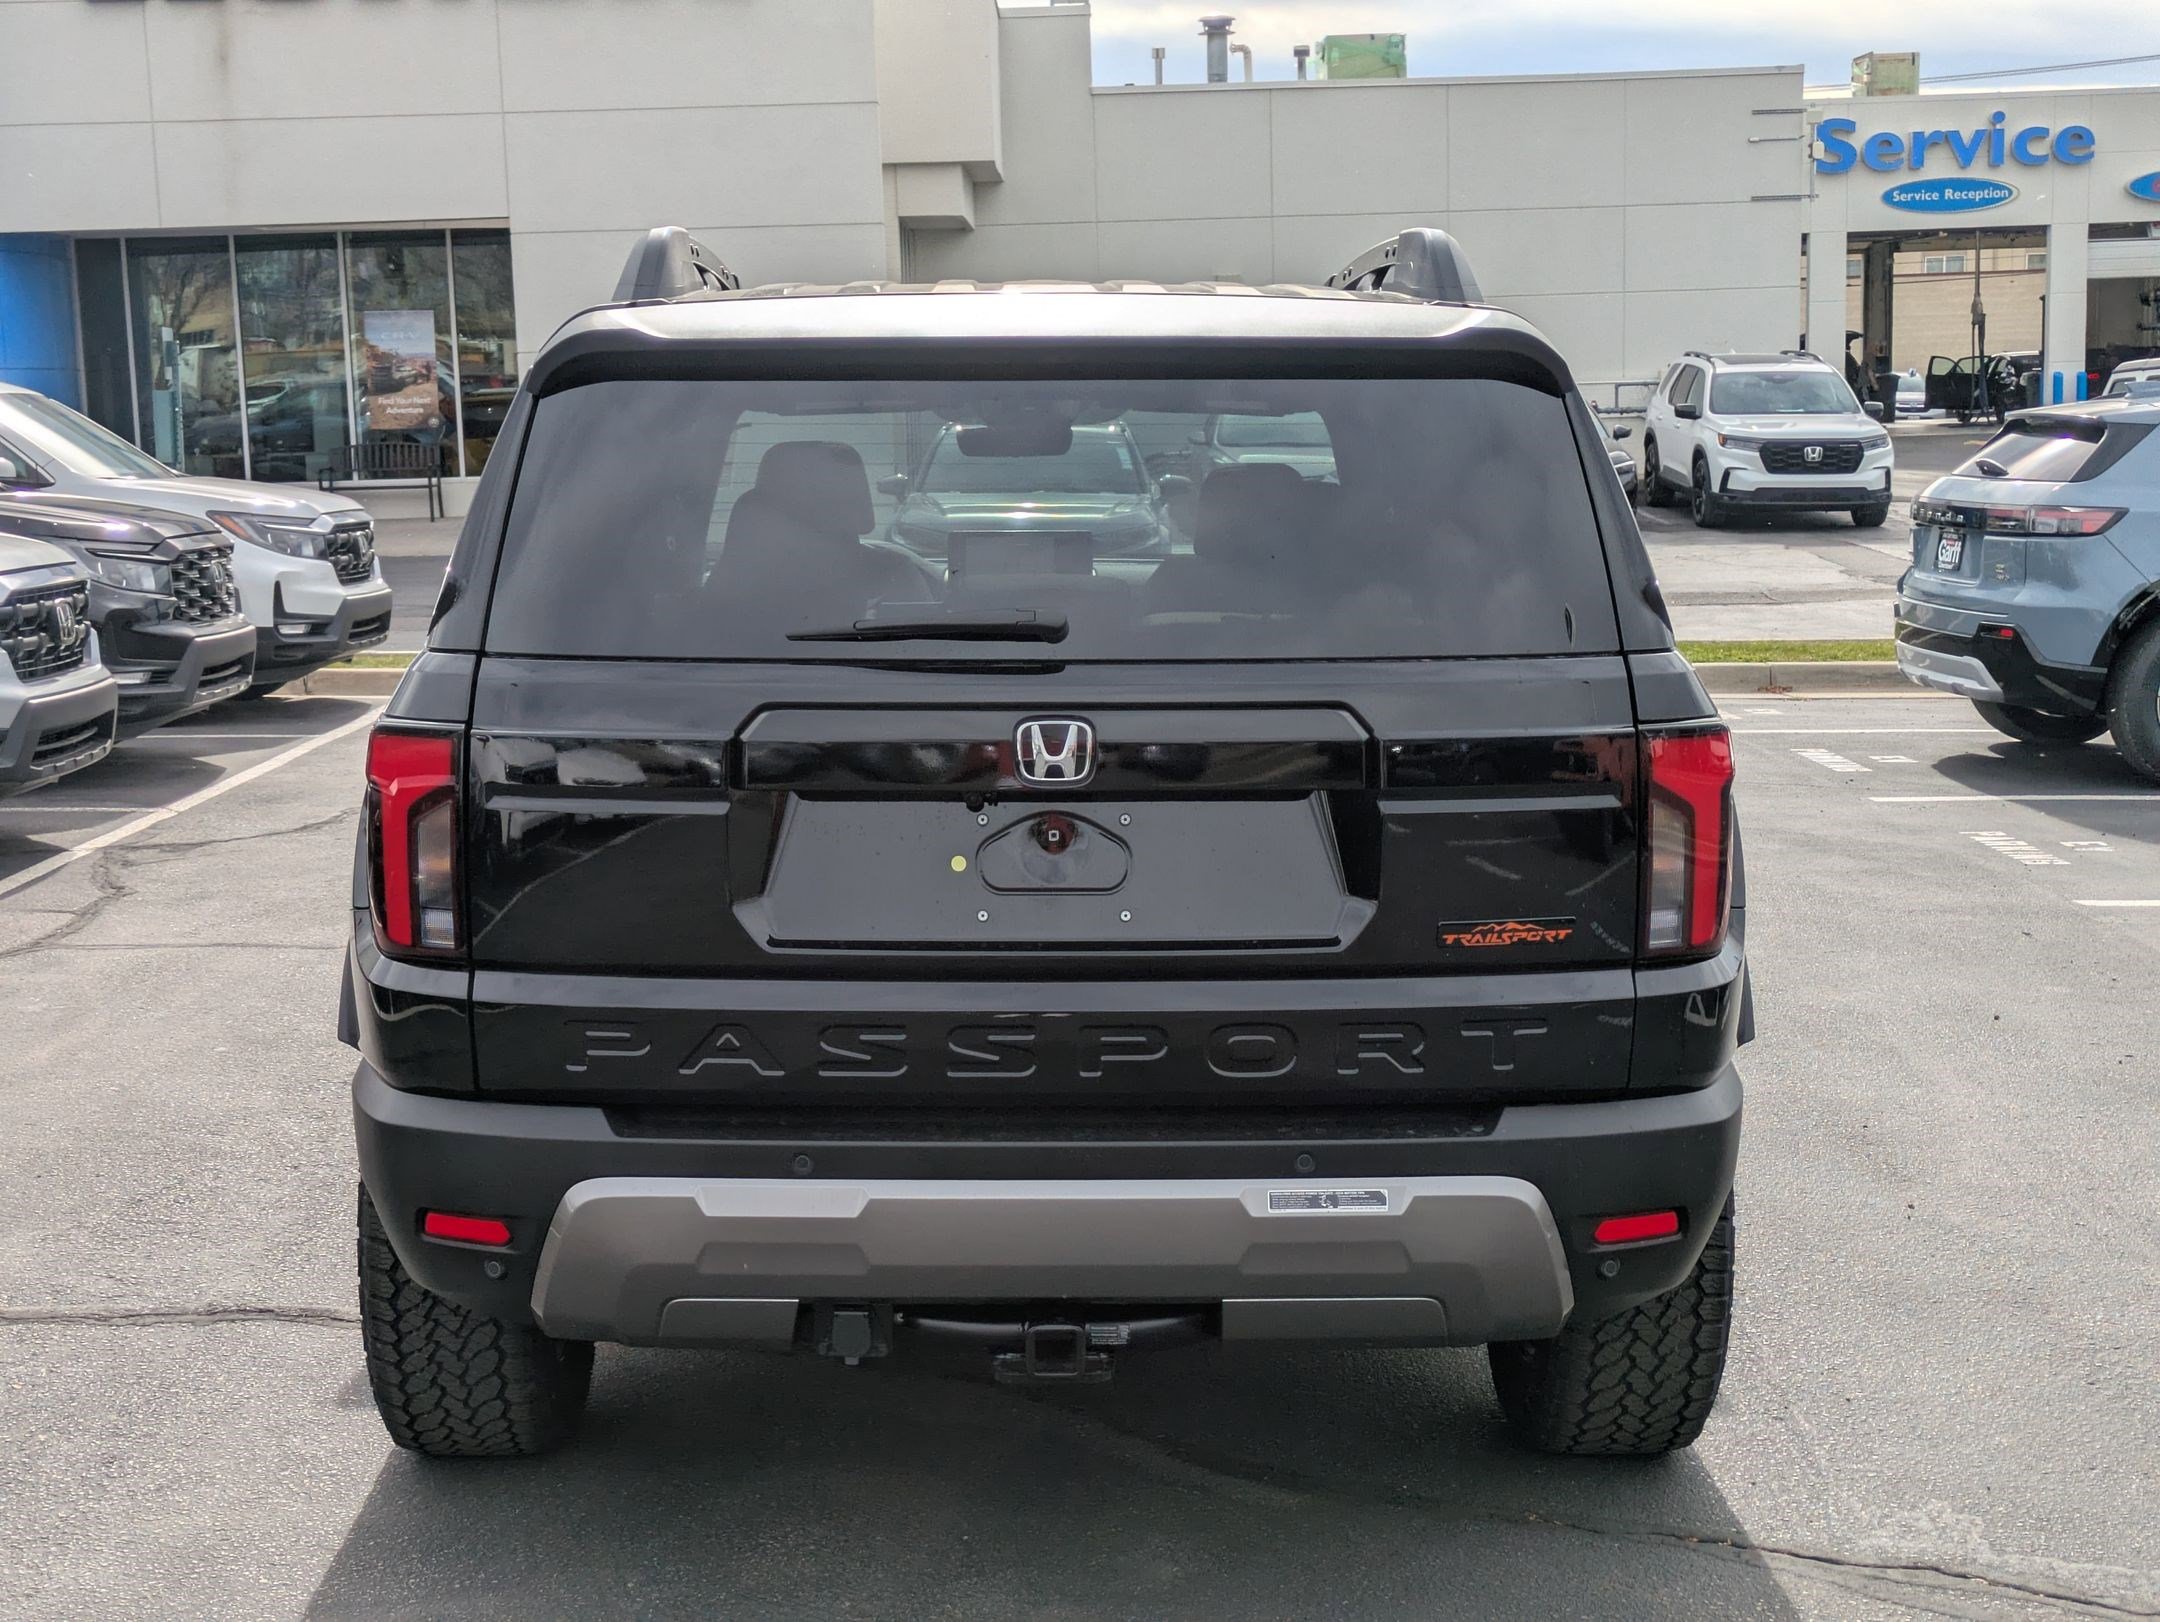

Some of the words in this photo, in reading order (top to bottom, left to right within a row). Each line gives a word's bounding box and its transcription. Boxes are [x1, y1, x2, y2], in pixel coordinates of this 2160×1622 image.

[1815, 110, 2096, 174] Service
[1892, 189, 1939, 202] Service
[1944, 186, 2009, 202] Reception
[1442, 928, 1573, 947] TRAILSPORT
[563, 1018, 1548, 1078] PASSPORT
